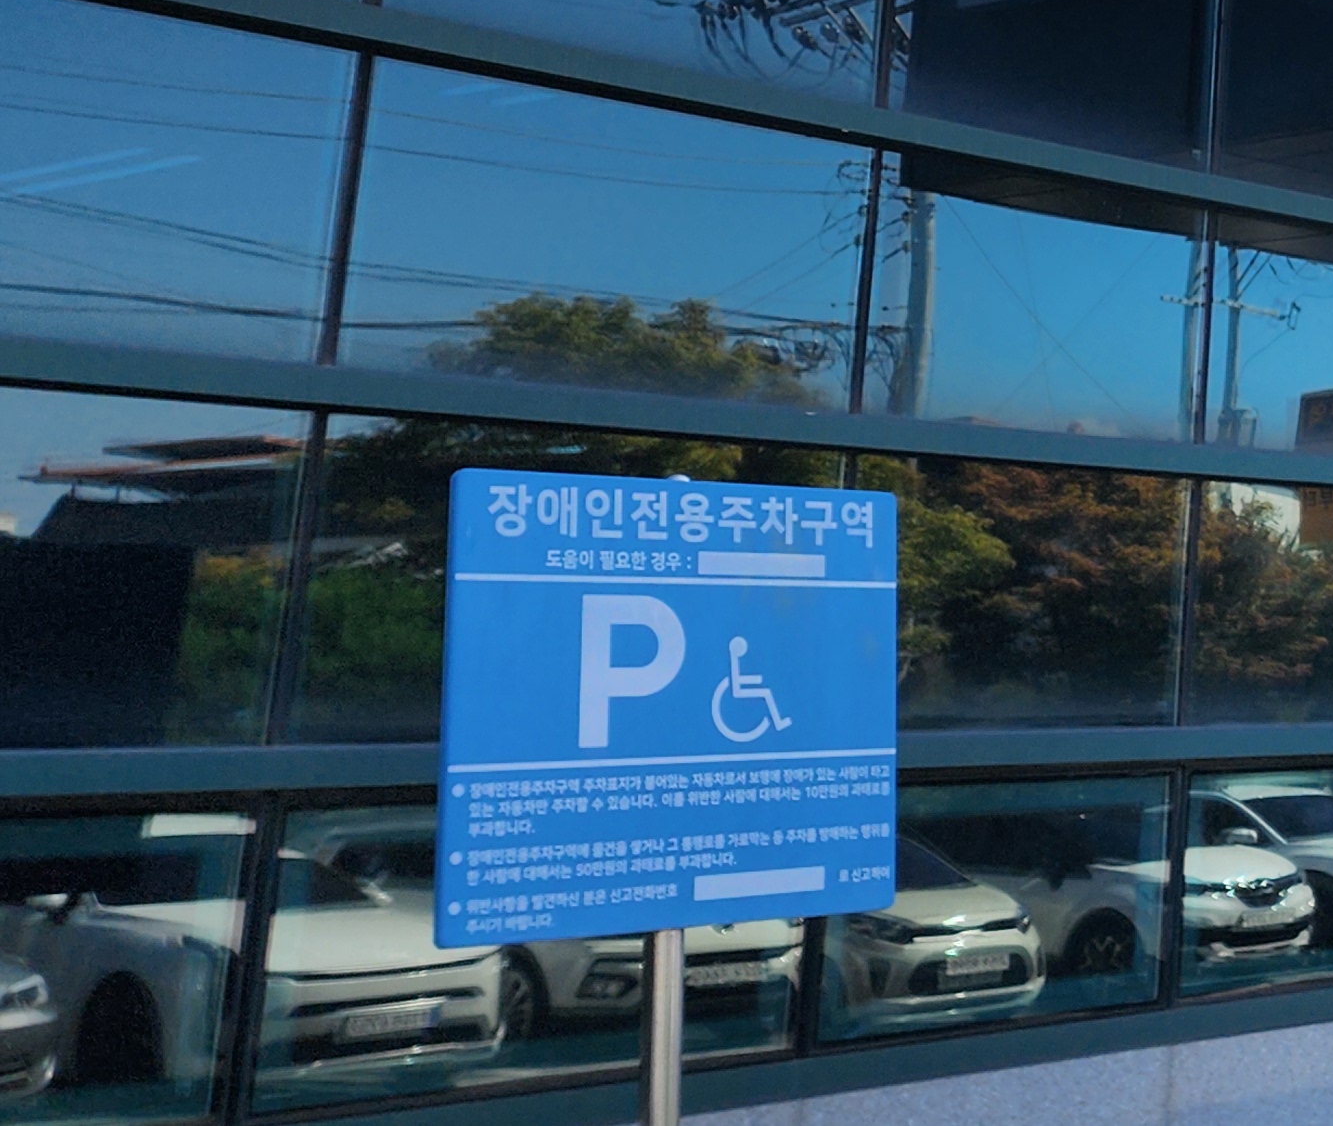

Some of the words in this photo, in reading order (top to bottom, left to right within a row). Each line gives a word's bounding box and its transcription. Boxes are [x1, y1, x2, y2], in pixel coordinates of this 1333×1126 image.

[487, 483, 874, 548] 장애인전용주차구역
[545, 549, 595, 569] 도움이
[599, 550, 647, 571] 필요한
[651, 552, 682, 572] 경우
[578, 594, 686, 749] P
